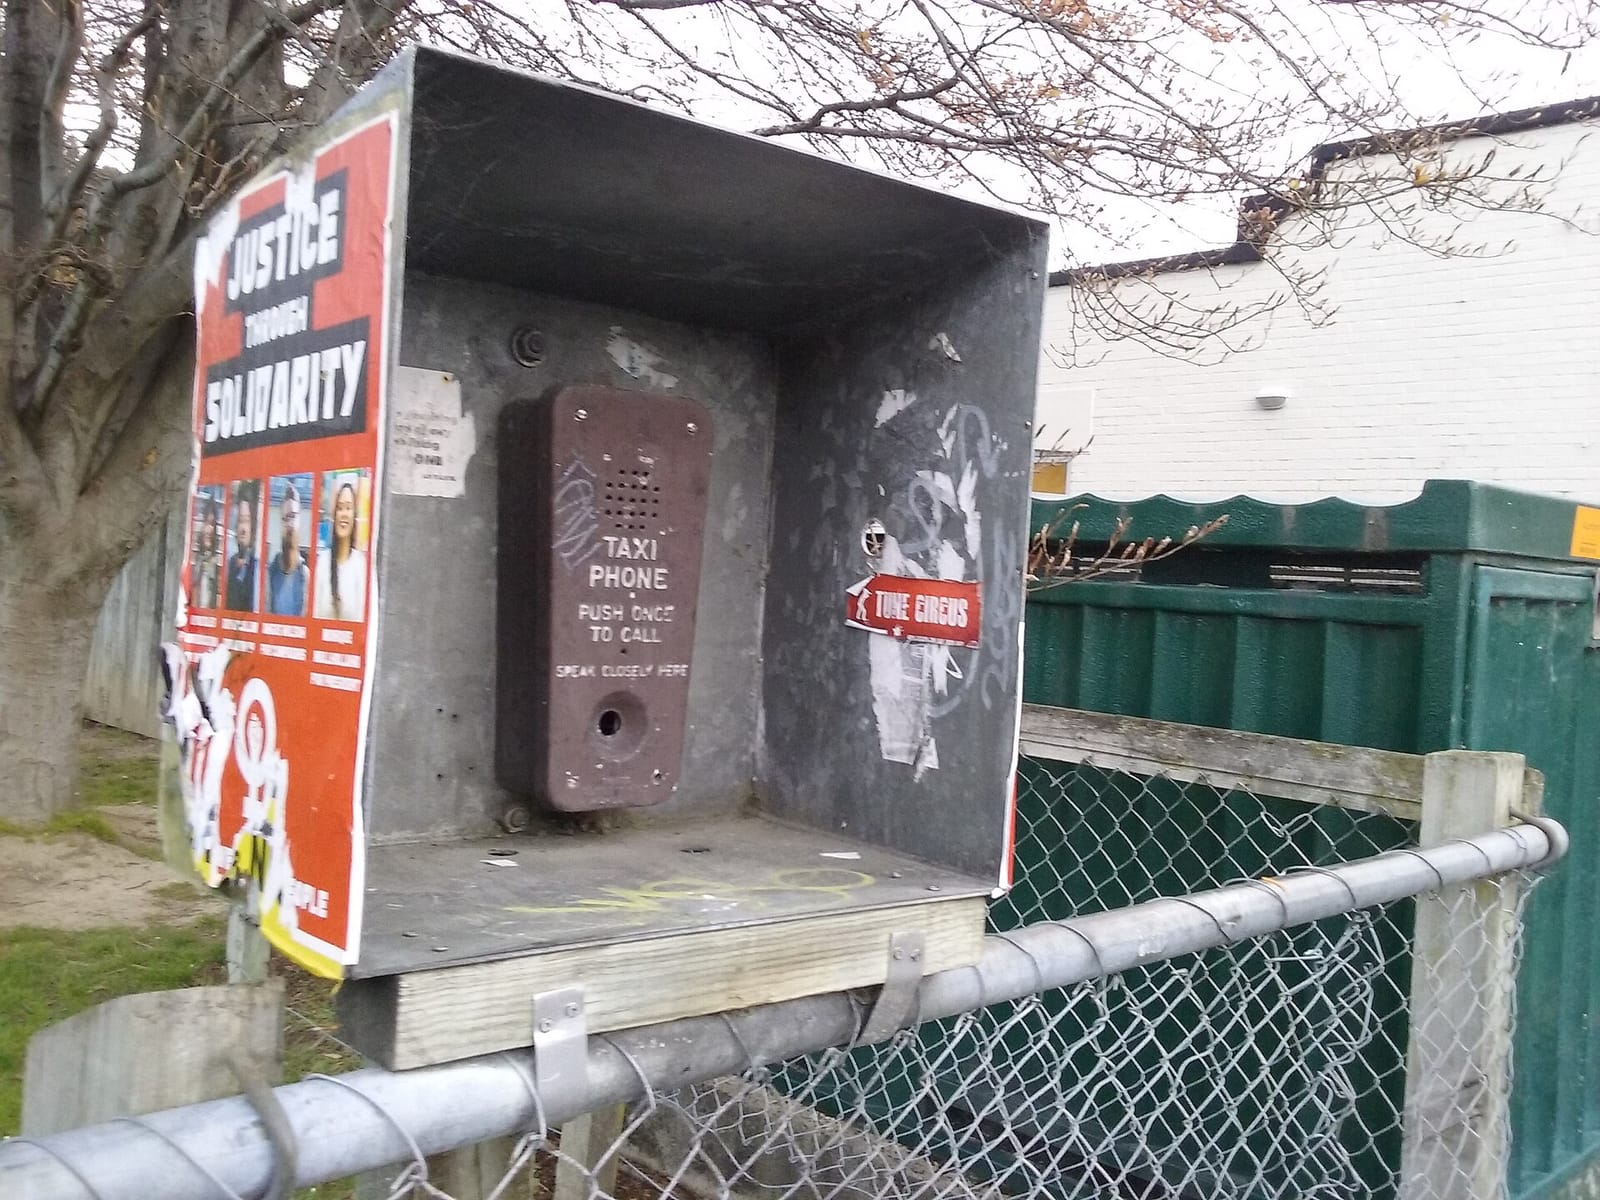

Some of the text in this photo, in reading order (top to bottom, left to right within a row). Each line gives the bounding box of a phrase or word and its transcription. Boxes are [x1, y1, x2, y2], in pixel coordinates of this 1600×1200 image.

[226, 188, 340, 301] JUSTICE
[204, 340, 367, 443] SOLIDARITY
[602, 536, 658, 561] TAXI
[588, 565, 670, 590] PHONE
[578, 604, 675, 622] PUSH ONCE
[915, 594, 969, 628] CIRCUS
[589, 626, 662, 643] TO CALL
[555, 664, 597, 678] SPEAK
[601, 664, 654, 678] CLOSELY
